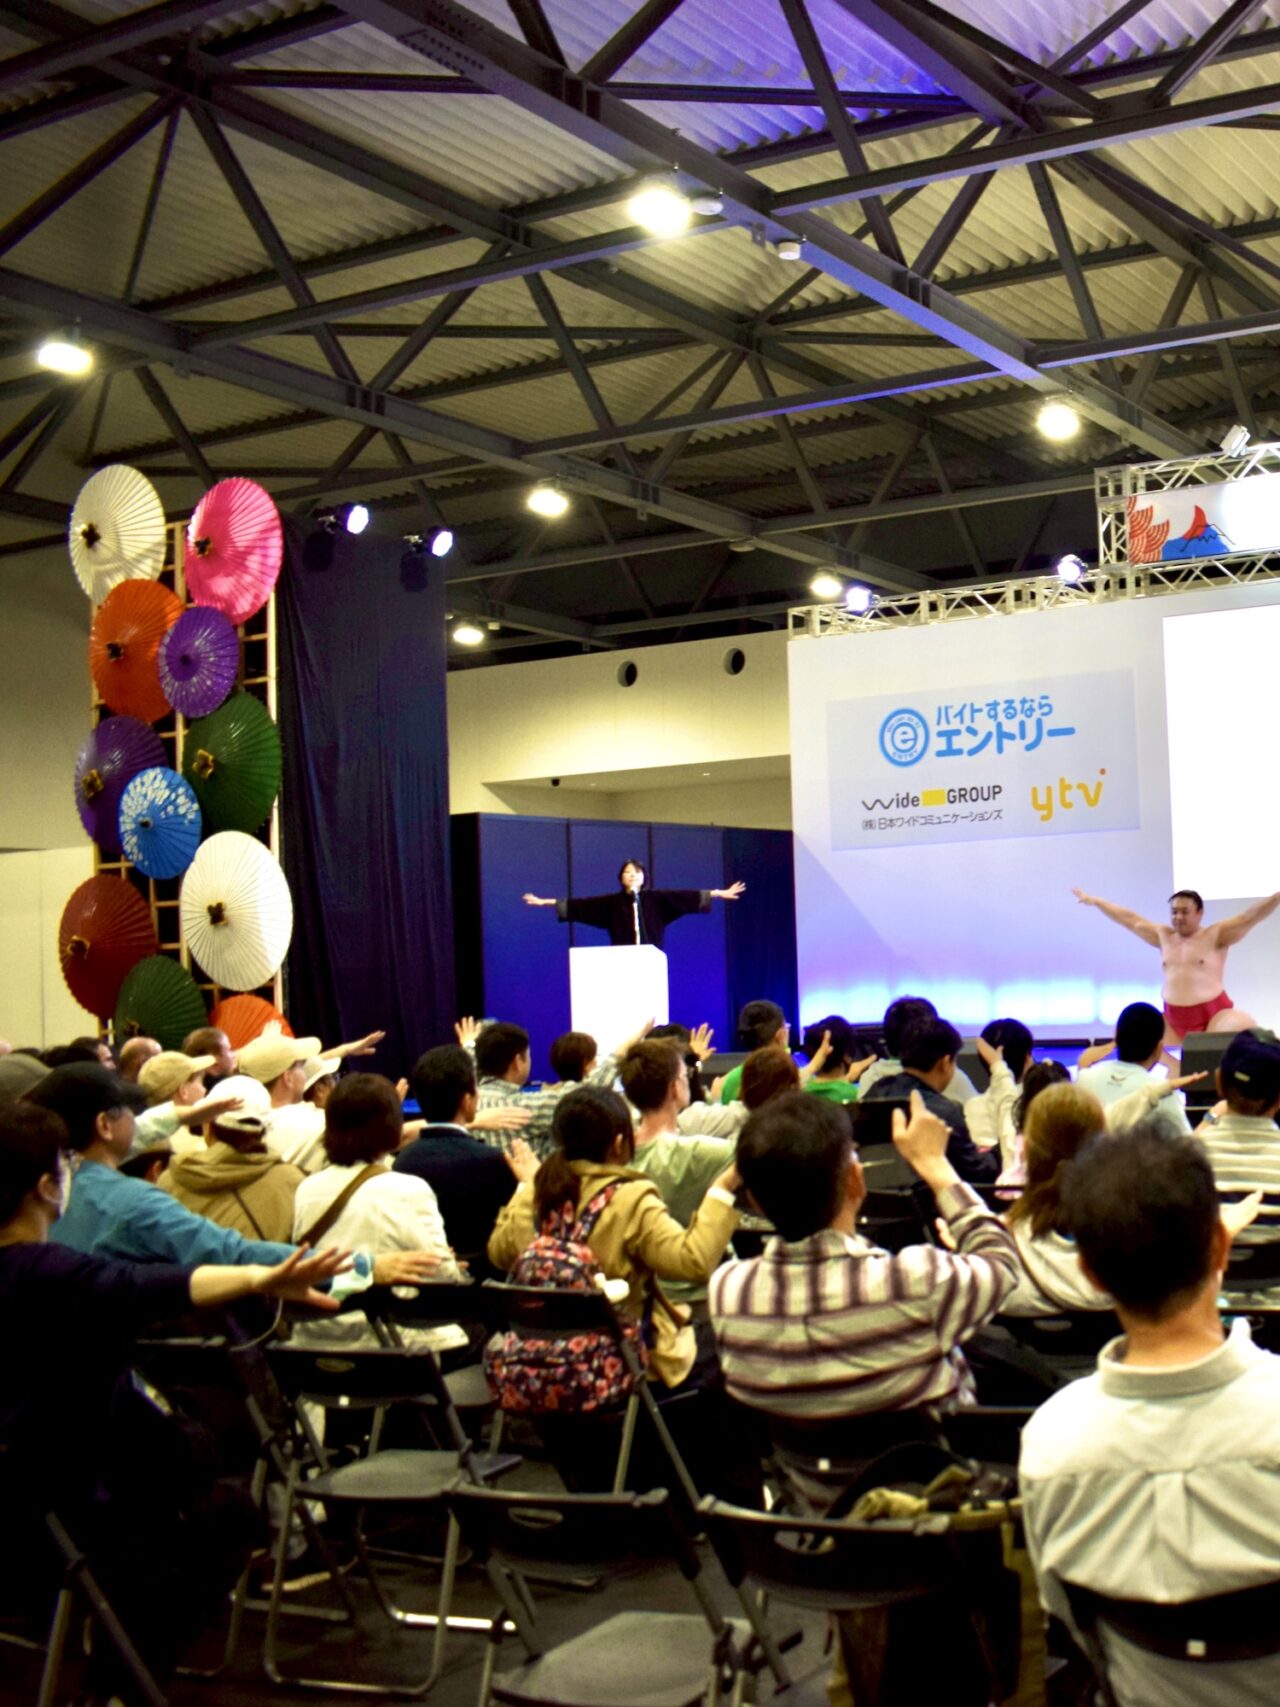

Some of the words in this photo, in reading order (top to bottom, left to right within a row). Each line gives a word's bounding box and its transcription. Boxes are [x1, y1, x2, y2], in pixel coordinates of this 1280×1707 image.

[936, 695, 1053, 726] バイトするなら
[935, 718, 1075, 757] エントリー
[861, 792, 920, 811] Wide
[946, 785, 1003, 804] GROUP
[1031, 768, 1106, 822] ytv
